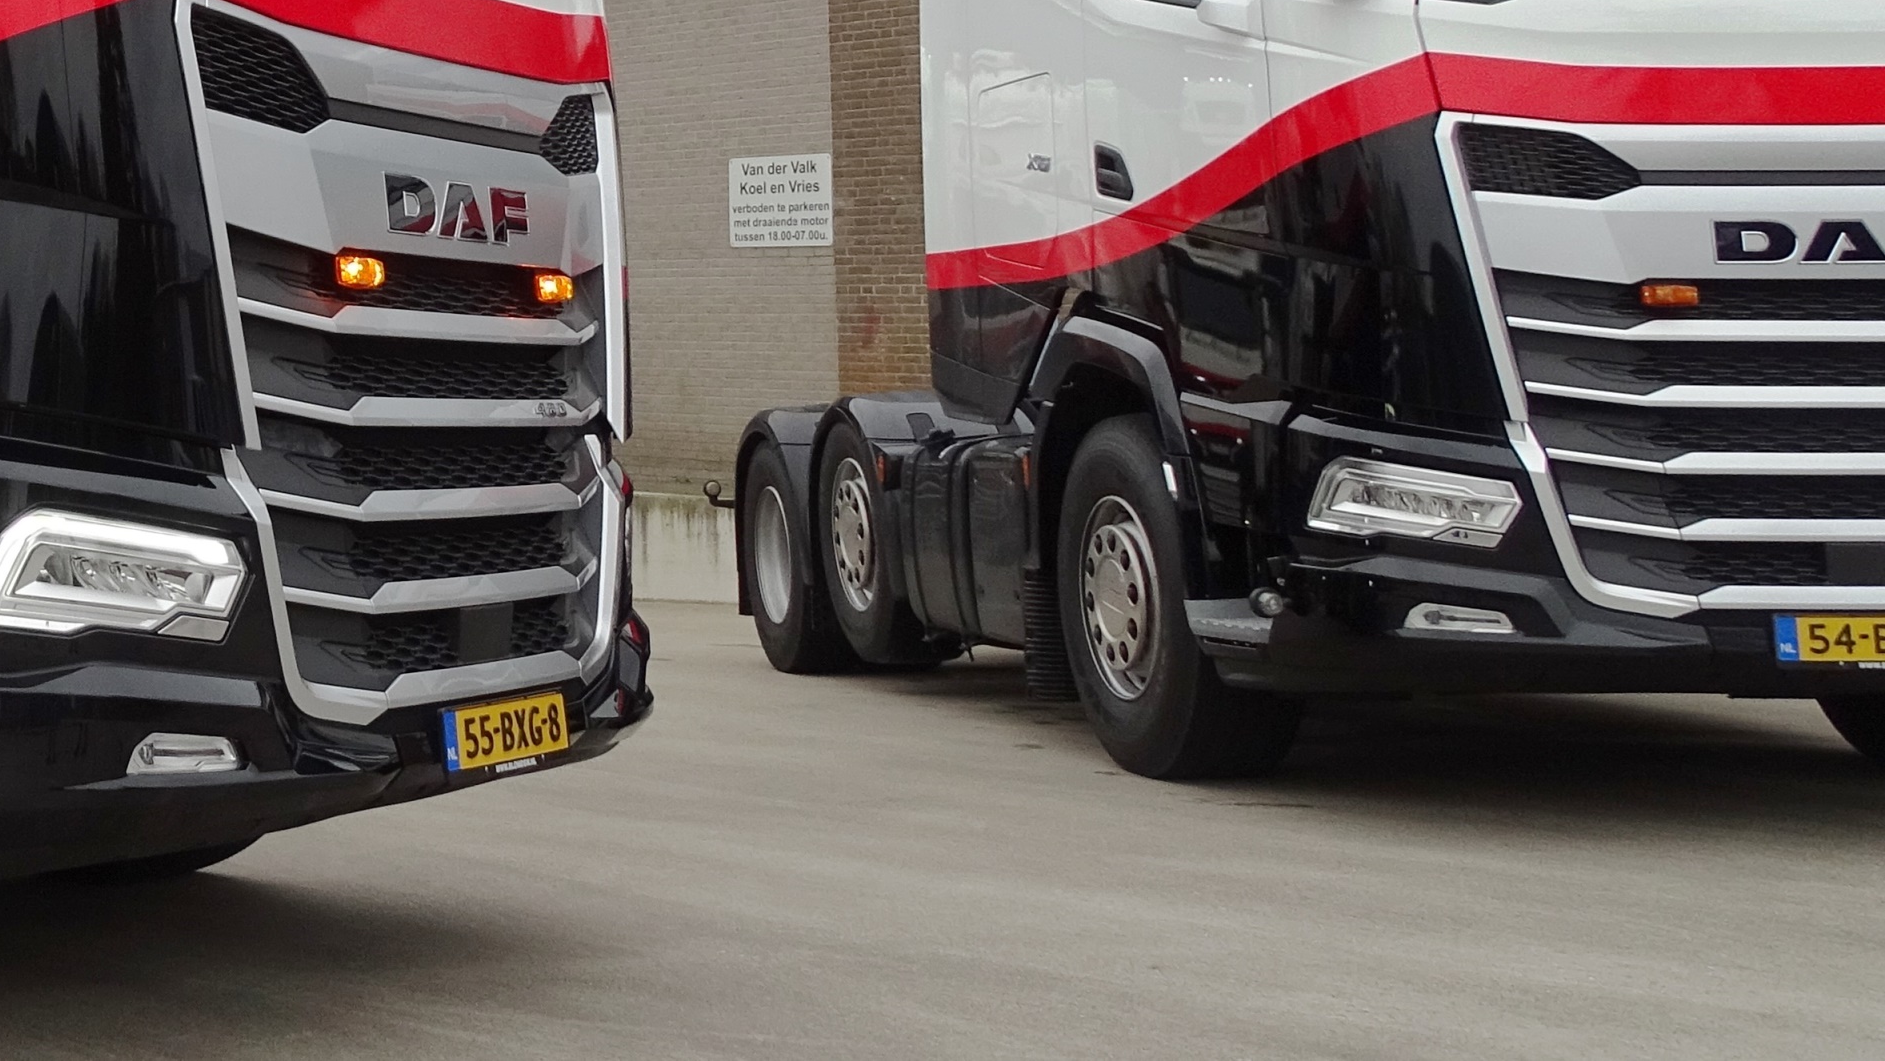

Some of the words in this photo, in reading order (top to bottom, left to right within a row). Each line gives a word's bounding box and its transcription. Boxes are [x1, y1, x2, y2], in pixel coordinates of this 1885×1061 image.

[741, 162, 764, 176] Van
[767, 162, 788, 175] der
[790, 160, 817, 174] Valk
[739, 181, 766, 195] Koel
[770, 183, 785, 194] en
[788, 180, 820, 193] Vries
[382, 170, 531, 247] DAF
[732, 203, 775, 214] verboden
[777, 203, 786, 213] te
[788, 201, 830, 214] parkeren
[733, 219, 750, 228] met
[752, 217, 798, 228] draaiende
[800, 217, 829, 226] motor
[734, 232, 765, 242] tussen
[1779, 642, 1797, 653] NL
[463, 702, 562, 759] 55-BXG-8
[447, 746, 459, 761] NL
